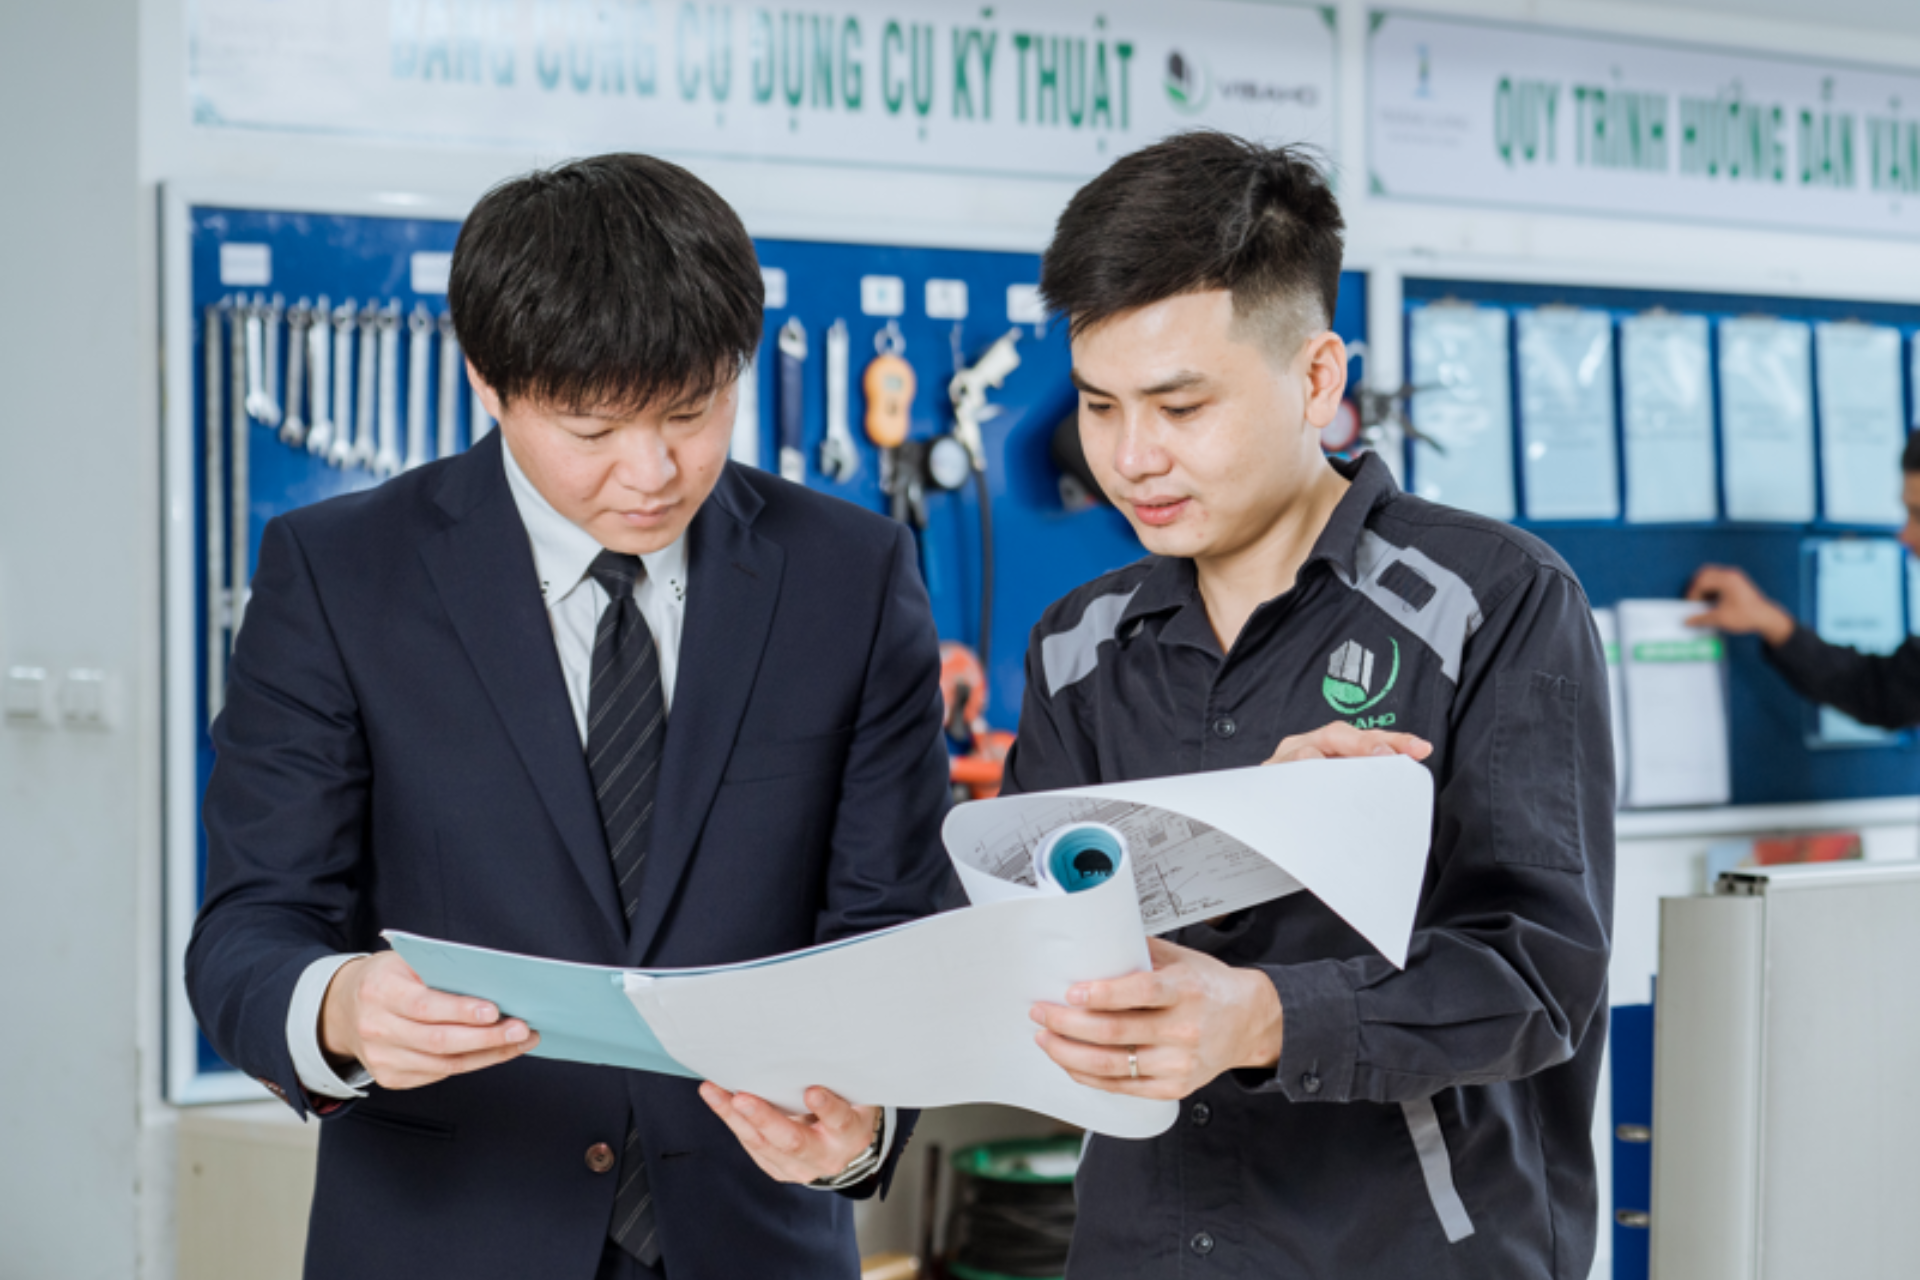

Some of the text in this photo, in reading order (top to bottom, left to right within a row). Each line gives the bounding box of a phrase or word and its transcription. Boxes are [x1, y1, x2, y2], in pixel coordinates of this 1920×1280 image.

[881, 18, 934, 141] CỤ
[1493, 75, 1561, 168] QUY
[1349, 711, 1397, 729] AHO
